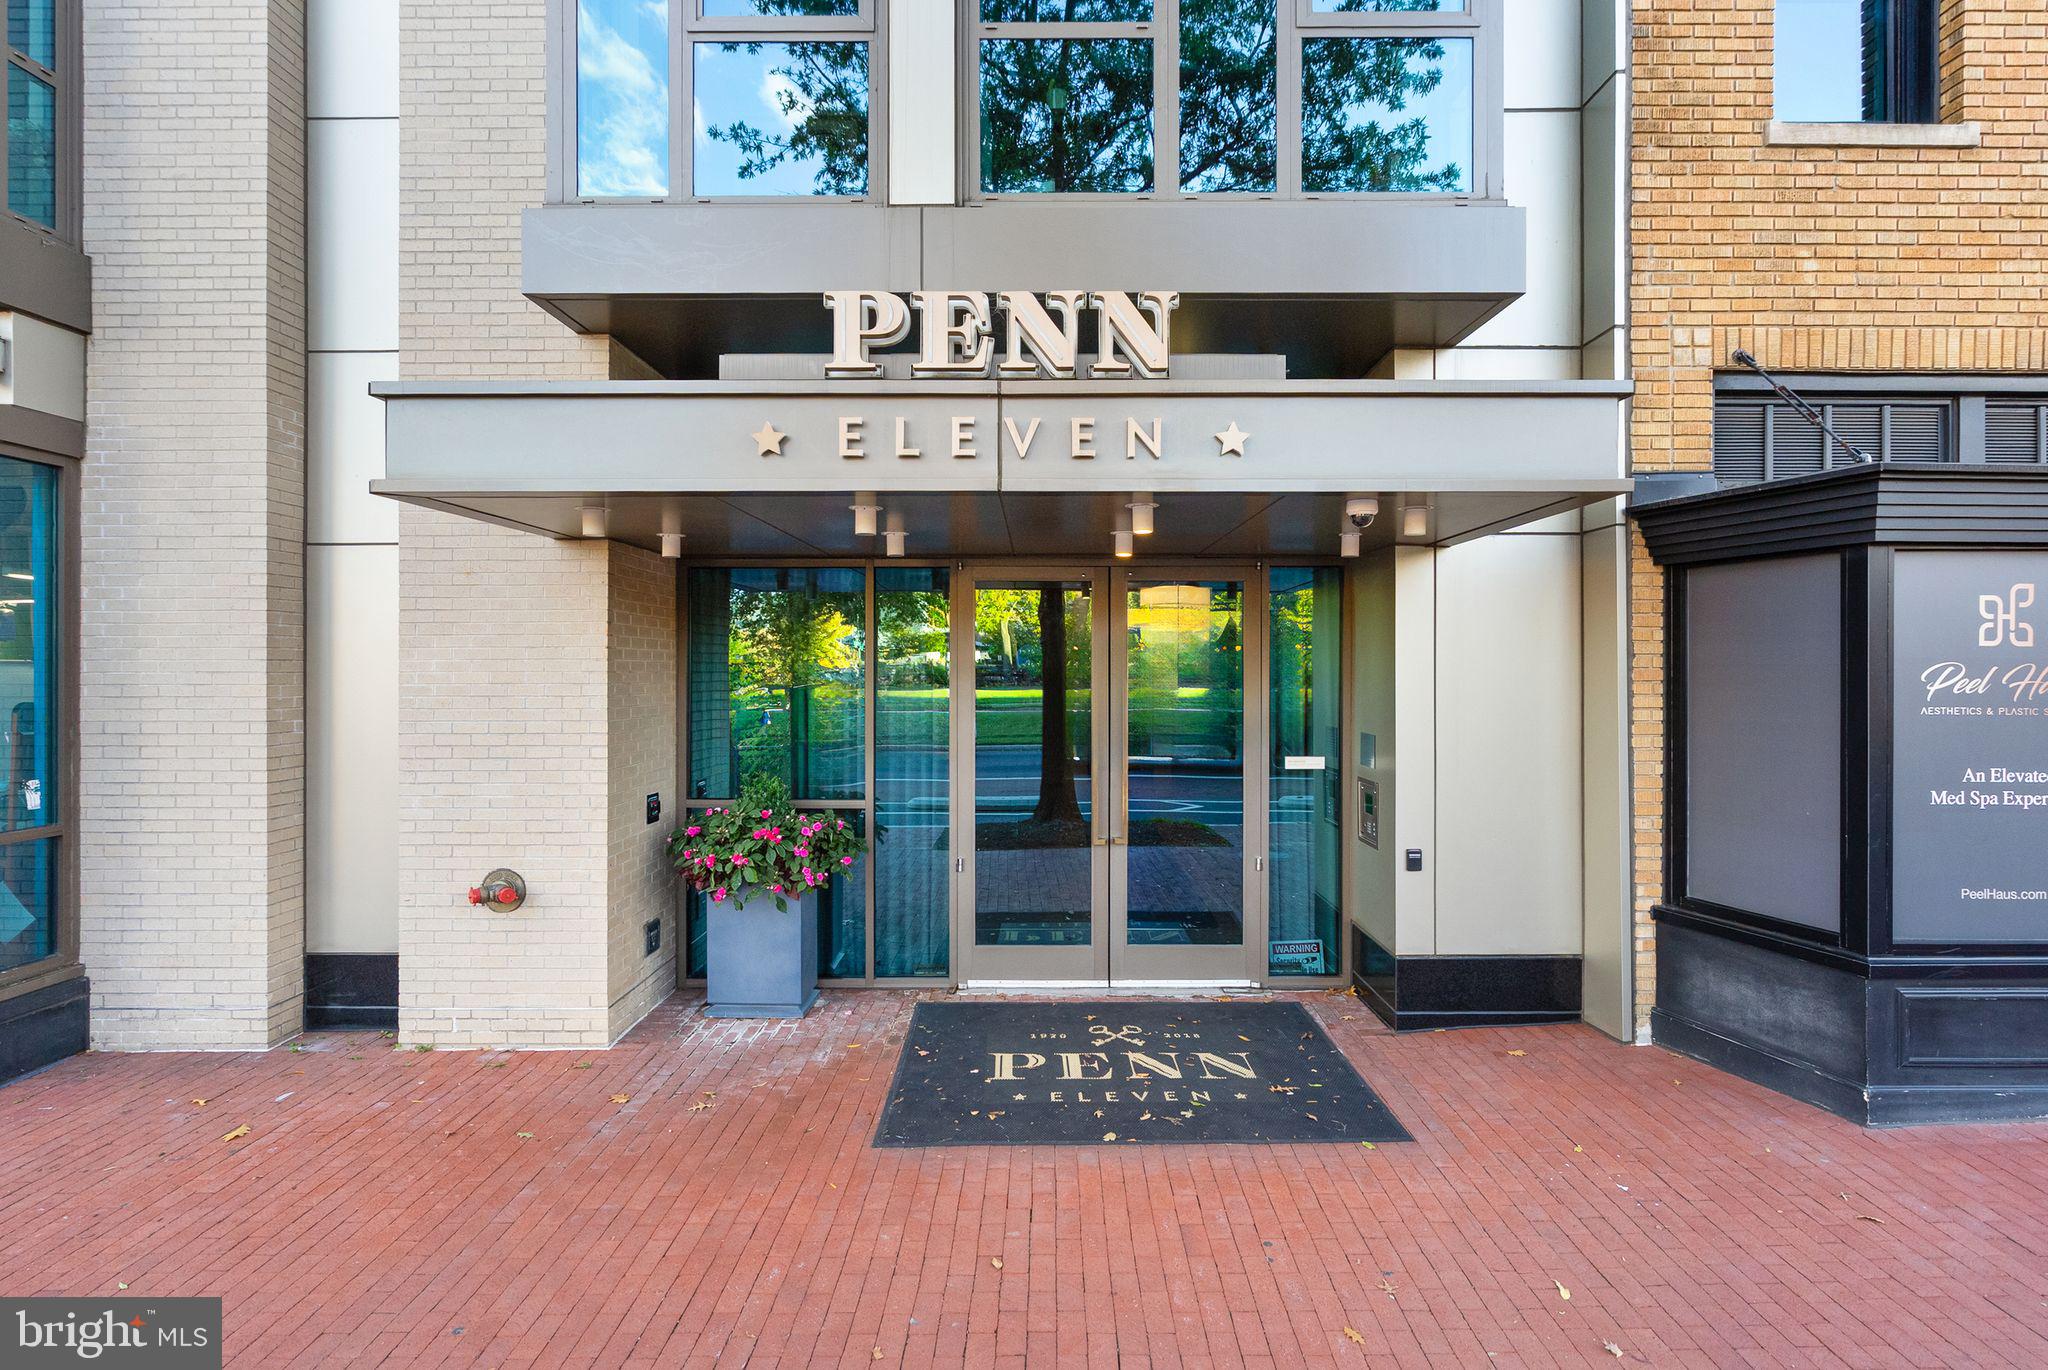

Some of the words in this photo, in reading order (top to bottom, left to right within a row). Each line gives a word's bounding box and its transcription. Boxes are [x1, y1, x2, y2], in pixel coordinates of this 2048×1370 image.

[823, 290, 1180, 379] PENN
[838, 416, 1162, 459] ELEVEN
[1920, 661, 1999, 702] Peel
[1920, 706, 1982, 716] AESTHETICS
[1986, 707, 1994, 716] &
[1998, 707, 2039, 716] PLASTIC
[1962, 767, 1986, 783] An
[1990, 767, 2048, 783] Elevate
[1930, 790, 1965, 806] Med
[1969, 790, 1999, 810] Spa
[1961, 888, 2048, 901] PeelHaus.com
[1274, 943, 1318, 954] WARNING
[988, 1052, 1257, 1080] PENN
[1050, 1091, 1211, 1101] ELEVEN
